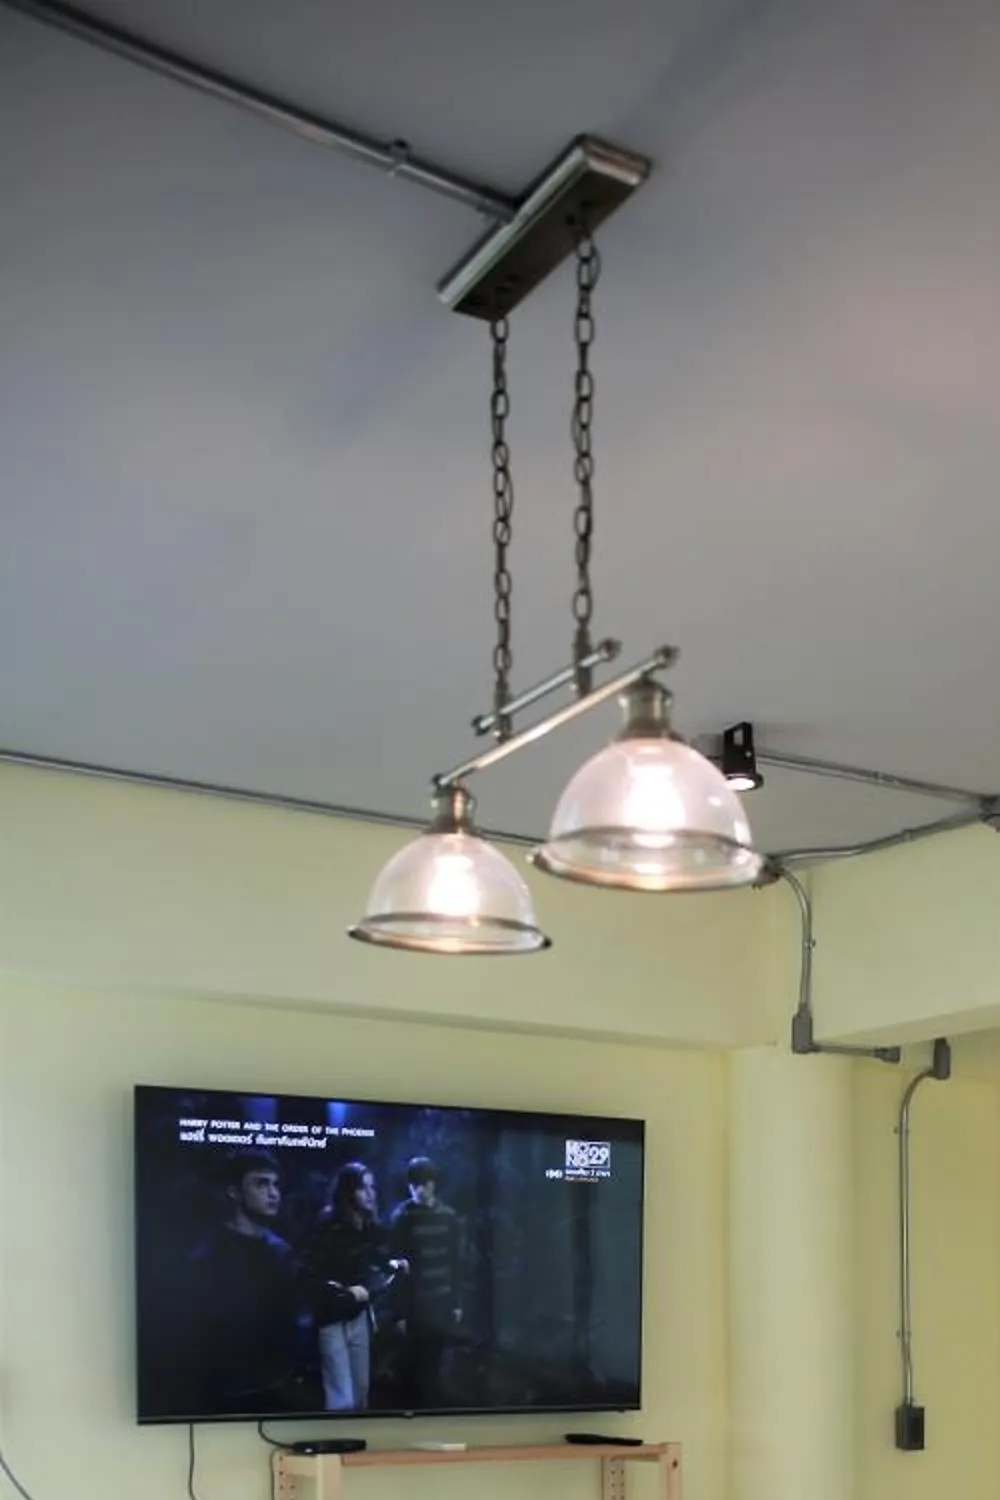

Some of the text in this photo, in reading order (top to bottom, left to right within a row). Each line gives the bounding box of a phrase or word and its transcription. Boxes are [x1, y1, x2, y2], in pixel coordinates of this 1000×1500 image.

[179, 1119, 208, 1127] HARRY
[211, 1120, 241, 1129] POTTER
[243, 1121, 262, 1131] AND
[265, 1123, 279, 1132] THE
[281, 1124, 308, 1133] ORDER
[311, 1125, 322, 1134] OF
[325, 1126, 339, 1135] THE
